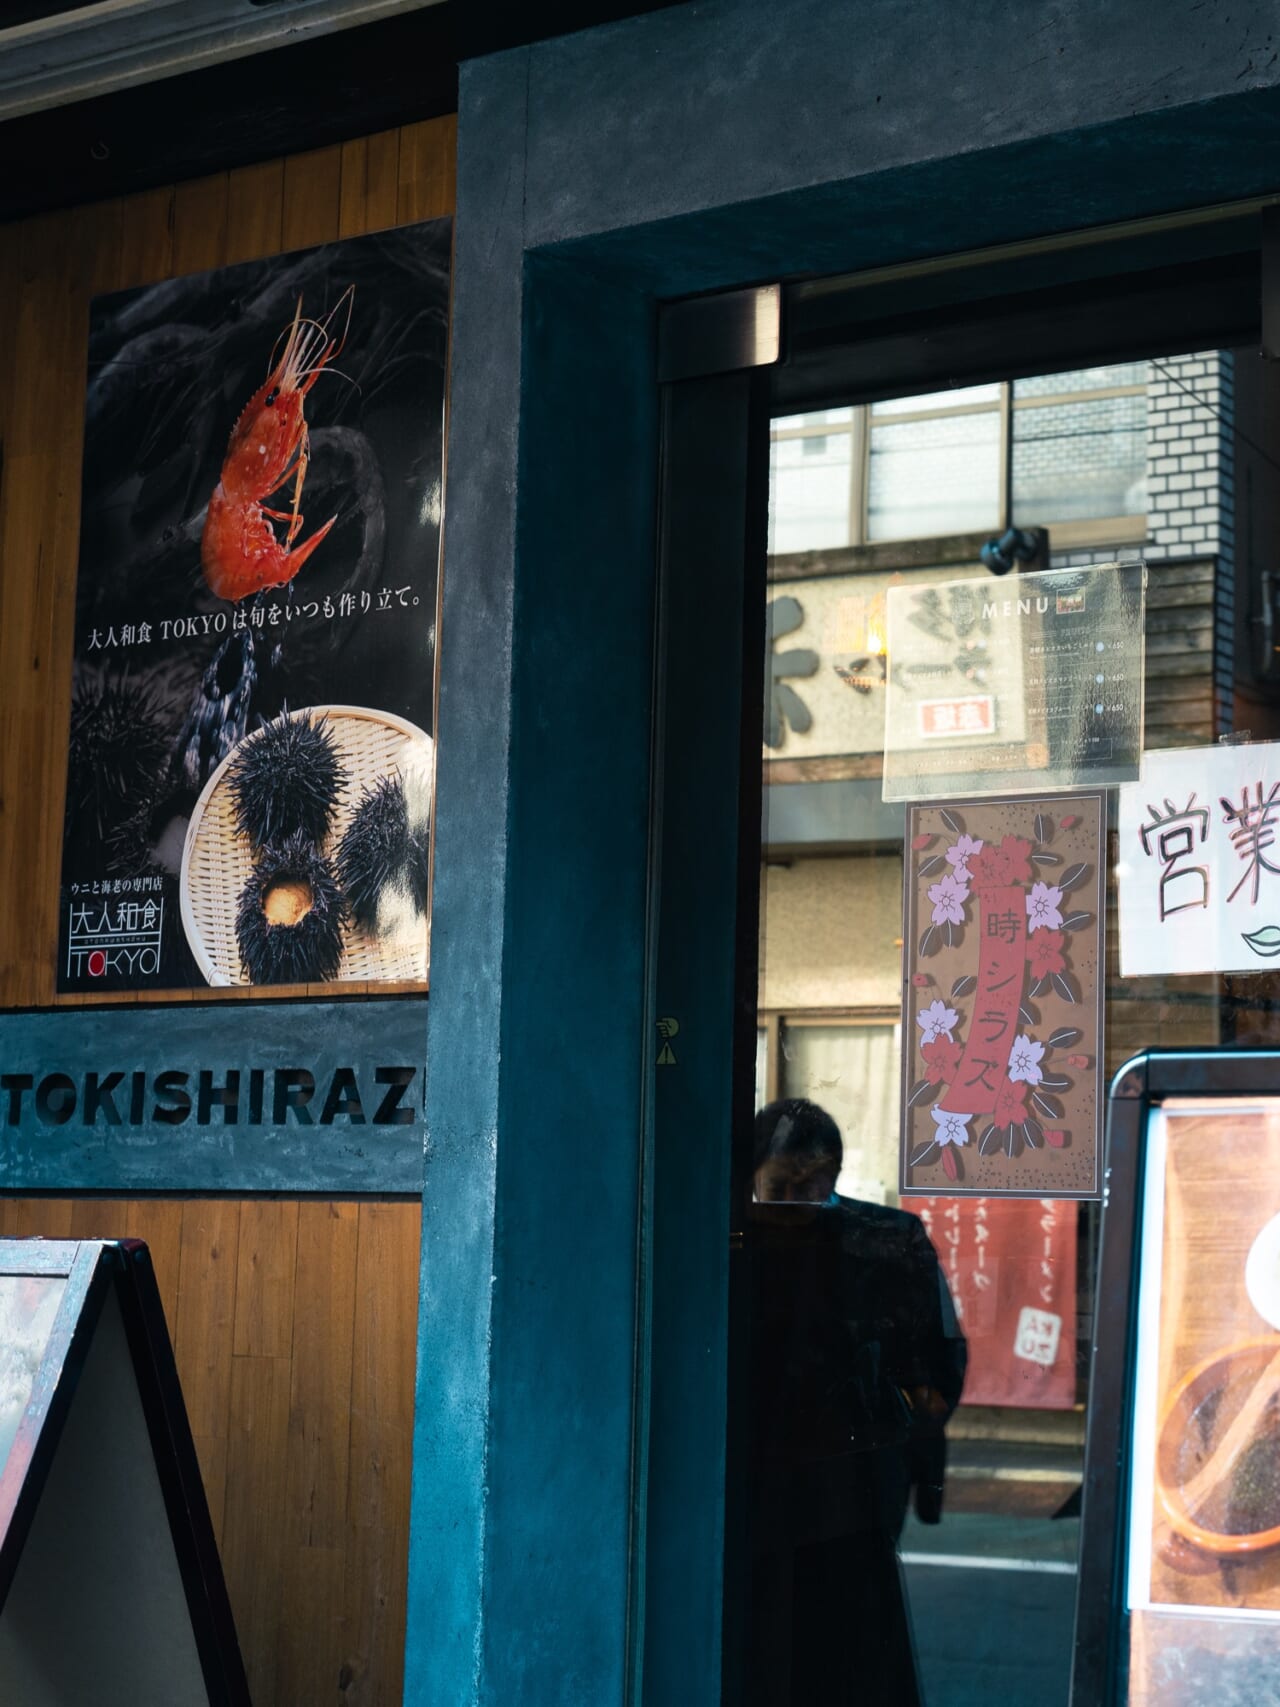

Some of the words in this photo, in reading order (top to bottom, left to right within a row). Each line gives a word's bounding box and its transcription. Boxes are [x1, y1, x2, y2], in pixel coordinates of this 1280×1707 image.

[87, 622, 153, 651] 大人和食
[160, 615, 226, 640] TOKYO
[233, 584, 421, 631] は旬をいつも作り立て。
[982, 597, 1049, 619] MENU
[71, 876, 163, 895] ウニと海老の専門店
[72, 898, 160, 934] 大人和食
[72, 948, 158, 977] TOKYO
[964, 908, 1022, 1091] 時シラズ
[0, 1067, 426, 1125] TOKISHIRAZ
